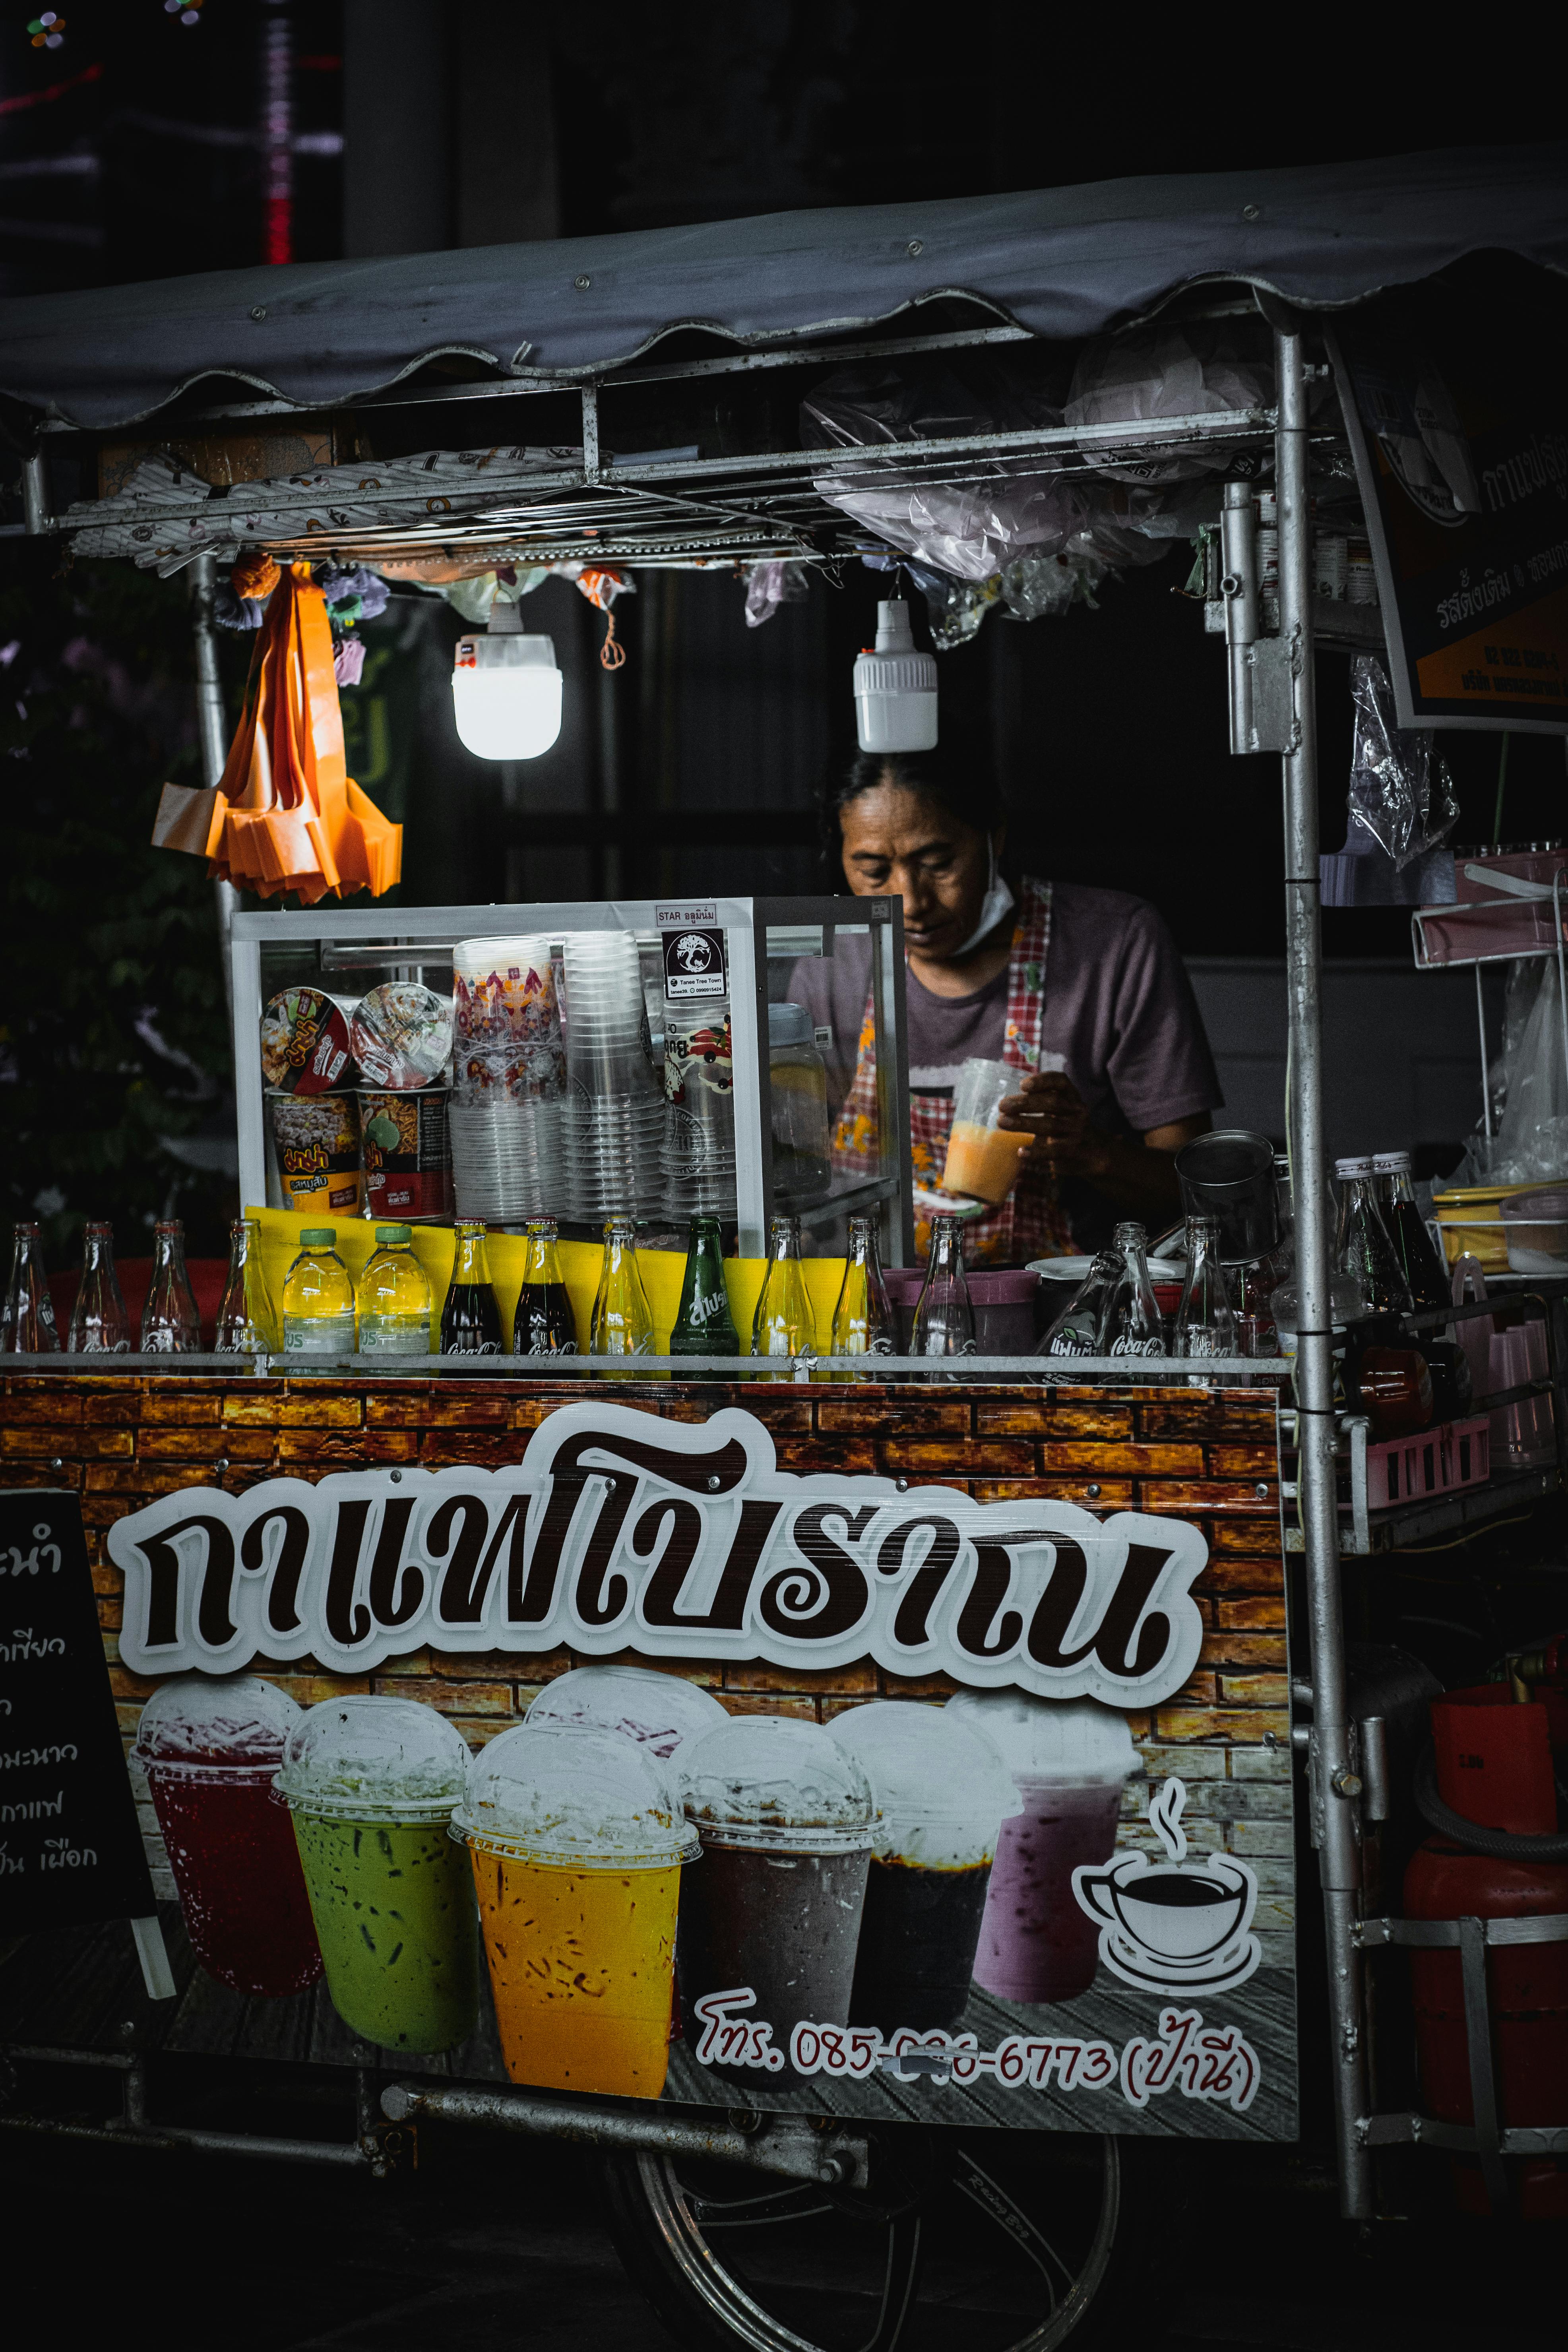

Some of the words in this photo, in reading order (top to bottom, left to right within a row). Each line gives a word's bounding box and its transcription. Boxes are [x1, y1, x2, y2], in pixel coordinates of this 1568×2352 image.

[659, 912, 680, 921] STAR
[284, 1143, 329, 1173] มาม่า
[290, 1176, 328, 1191] รสหมูสับ
[134, 1431, 1173, 1678] กาแฟโบราณ
[41, 1838, 98, 1870] เผือก
[701, 1994, 781, 2065] โทร.
[1128, 2015, 1254, 2104] (ป้านี)
